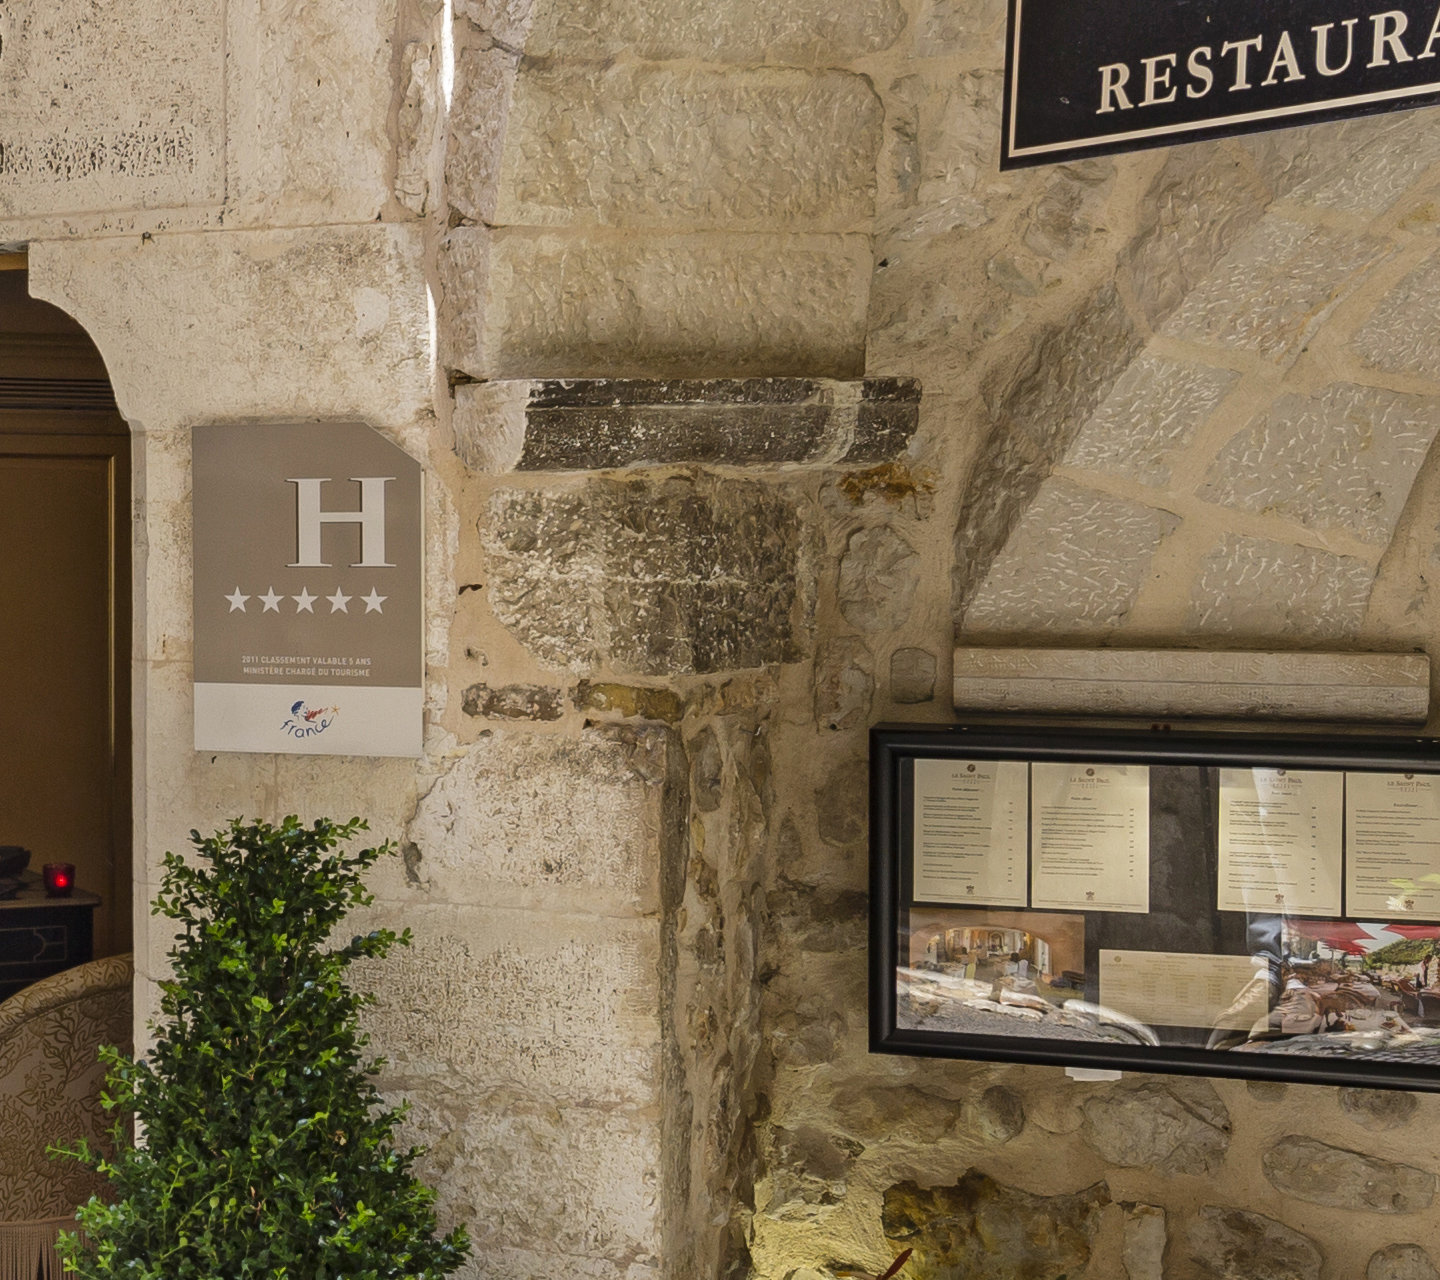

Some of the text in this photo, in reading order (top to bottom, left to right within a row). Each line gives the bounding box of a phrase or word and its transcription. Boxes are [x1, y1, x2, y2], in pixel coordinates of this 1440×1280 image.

[284, 476, 398, 568] H
[241, 655, 259, 664] 2011
[260, 656, 311, 665] CLASSEMENT
[312, 657, 346, 666] VALABLE
[355, 657, 372, 666] ANS
[318, 668, 329, 676] DU
[330, 668, 370, 677] TOURISME
